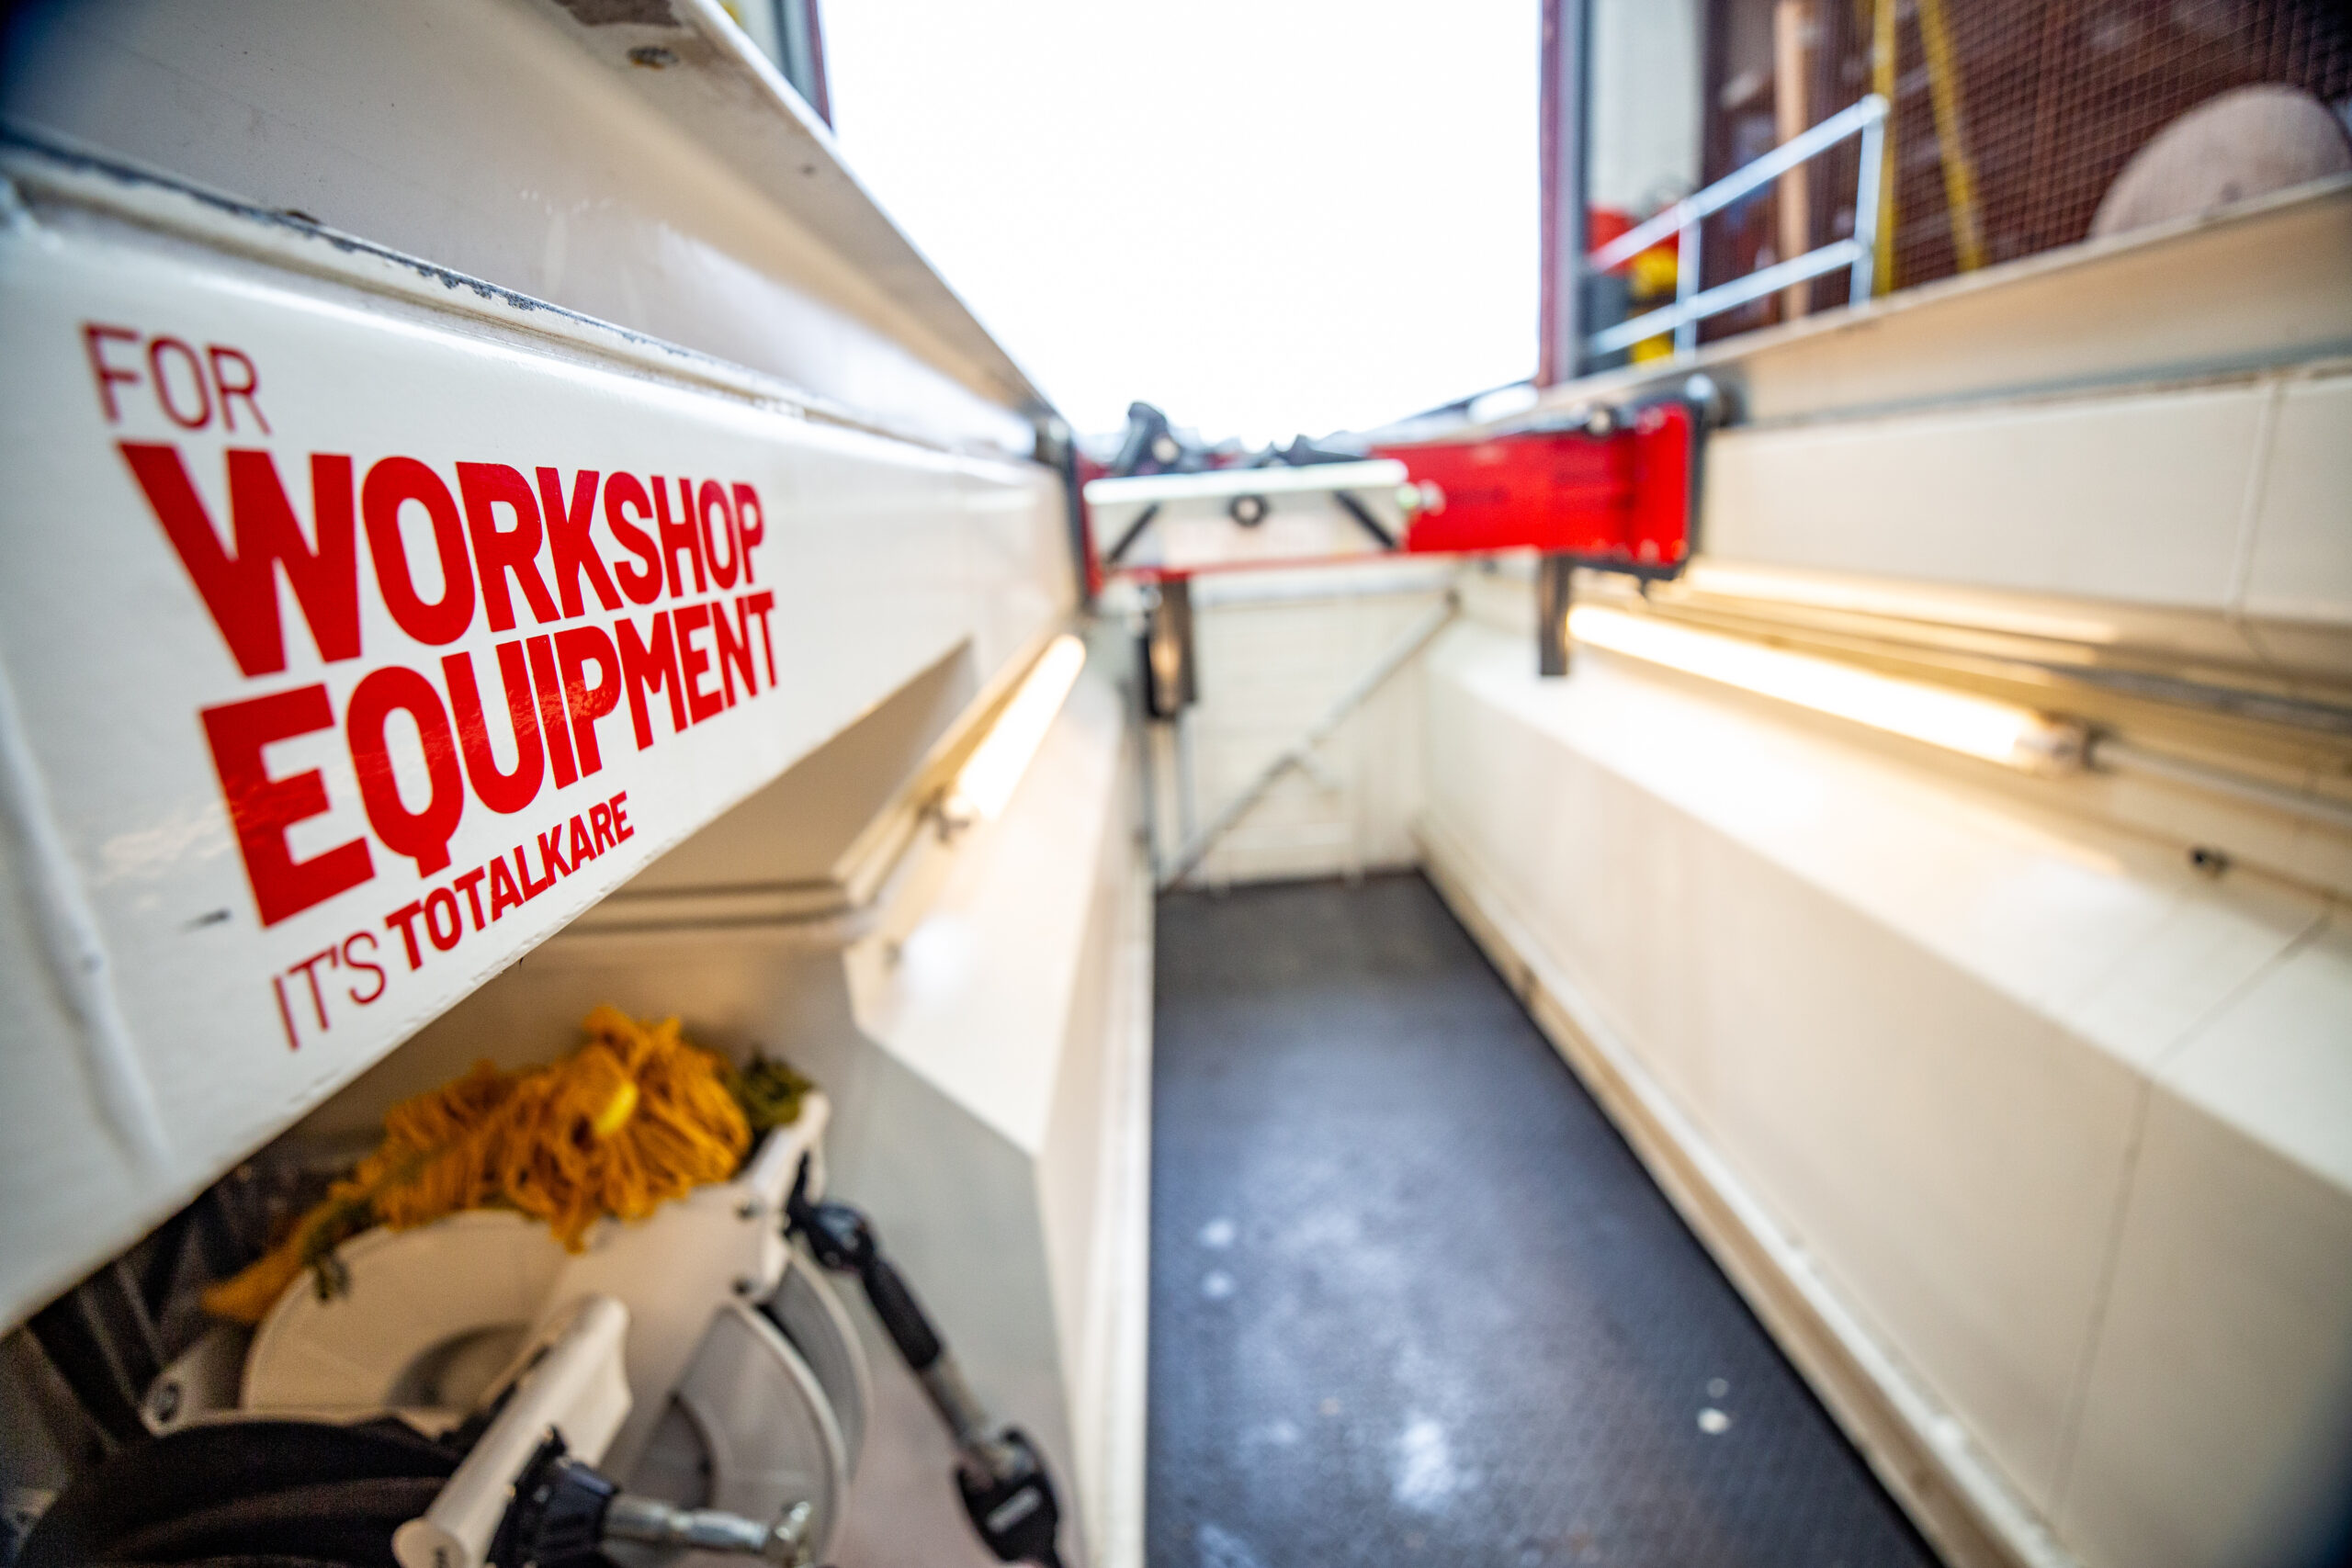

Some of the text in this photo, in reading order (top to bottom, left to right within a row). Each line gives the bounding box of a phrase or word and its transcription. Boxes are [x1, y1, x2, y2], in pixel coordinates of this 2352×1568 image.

[82, 322, 270, 434] FOR
[117, 441, 764, 678] WORKSHOP
[198, 590, 778, 929] EQUIPMENT
[271, 790, 635, 1051] IT'S TOTALKARE
